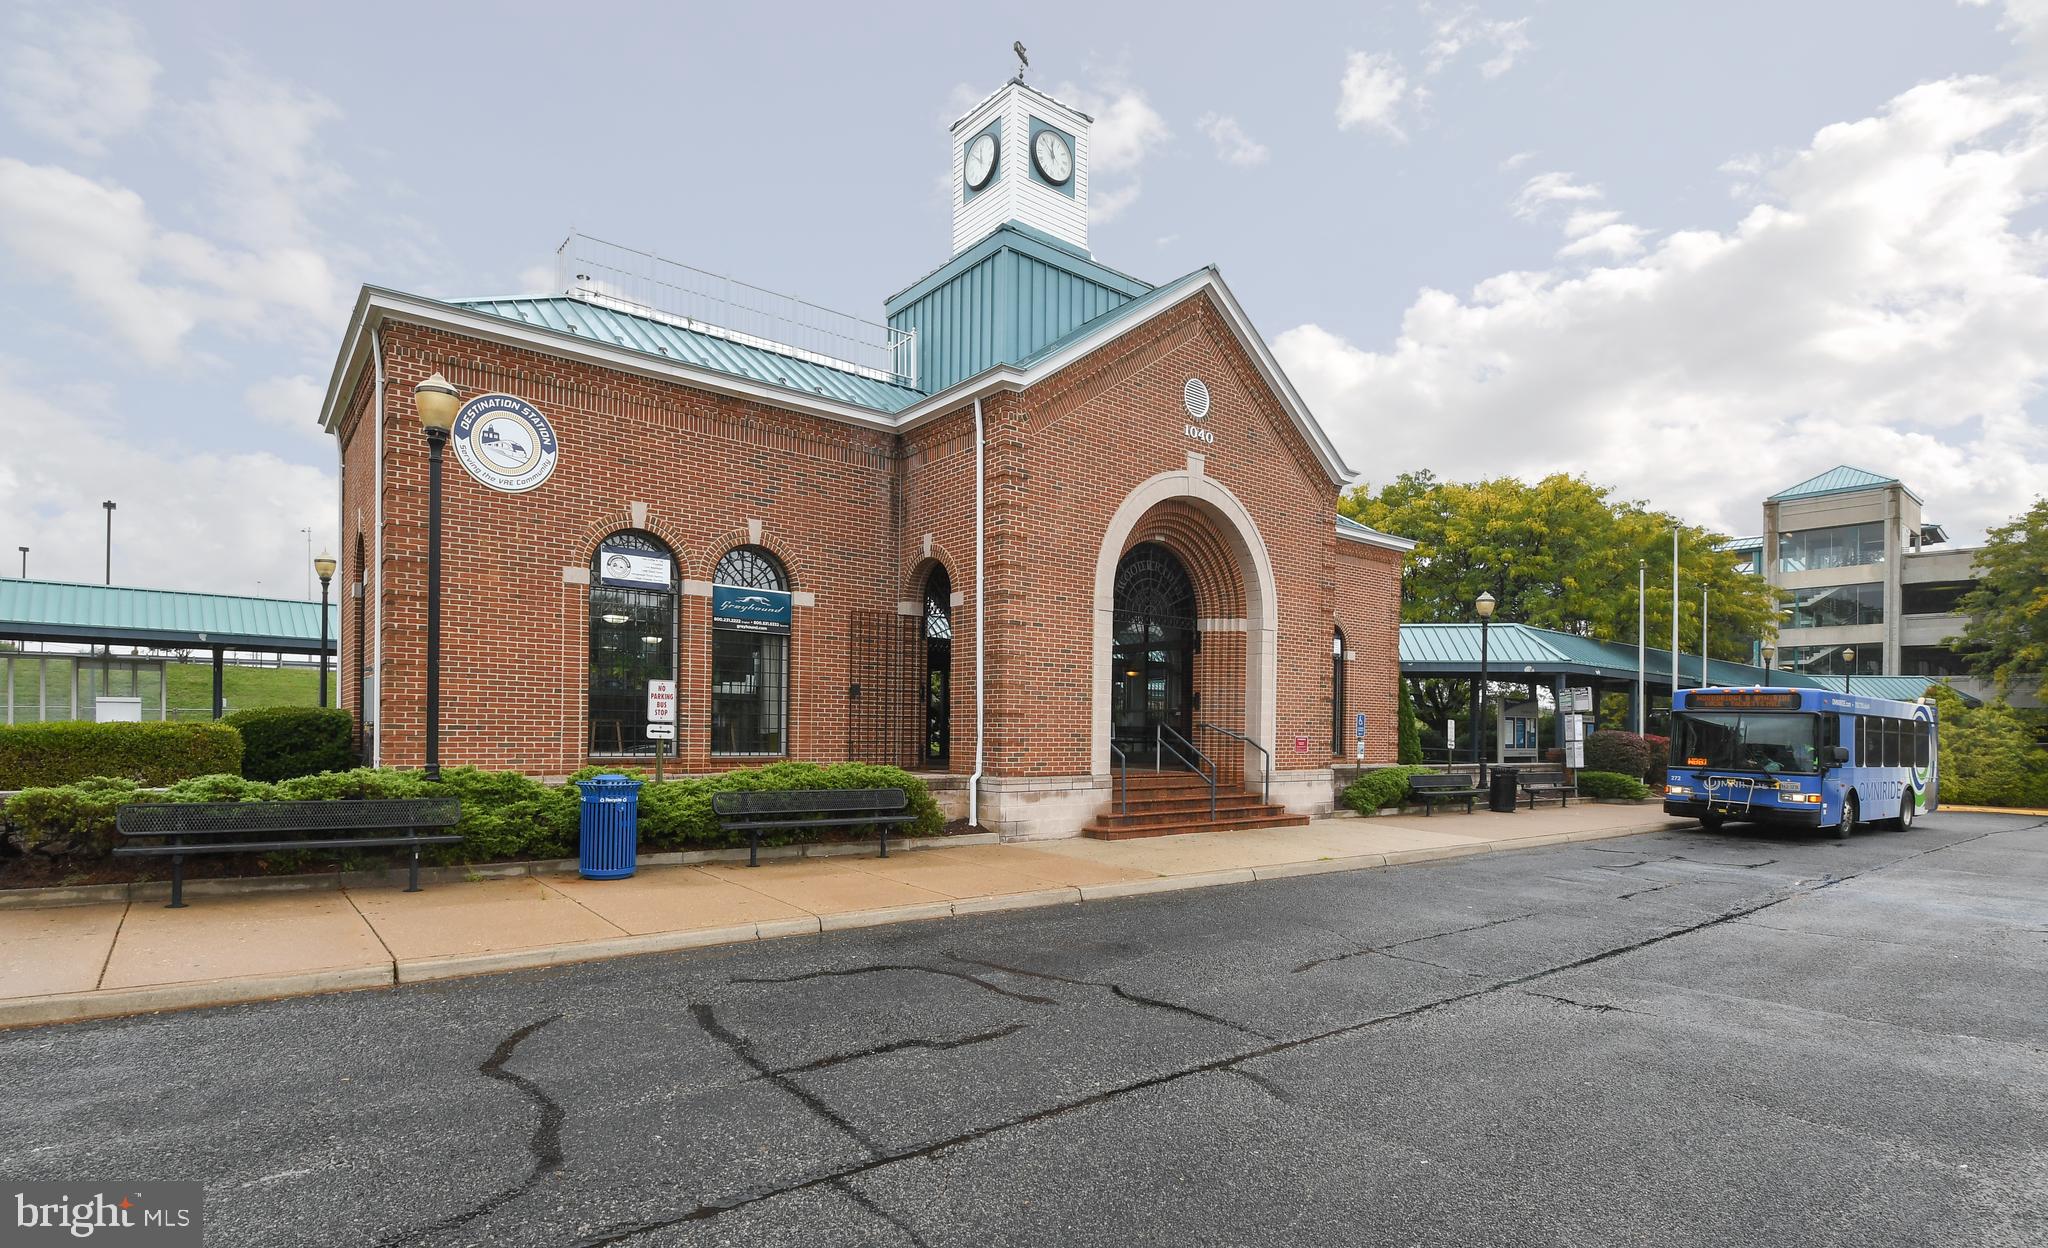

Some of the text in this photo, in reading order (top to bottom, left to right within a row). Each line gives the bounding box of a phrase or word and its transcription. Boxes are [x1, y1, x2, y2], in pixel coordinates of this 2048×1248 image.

[460, 398, 552, 446] DESTINATION STATION
[1184, 424, 1214, 444] 1040
[459, 444, 481, 473] Serving
[482, 472, 495, 482] the
[516, 458, 551, 485] Community
[719, 600, 785, 613] Greyhound
[1859, 781, 1902, 801] OMNIRIDE
